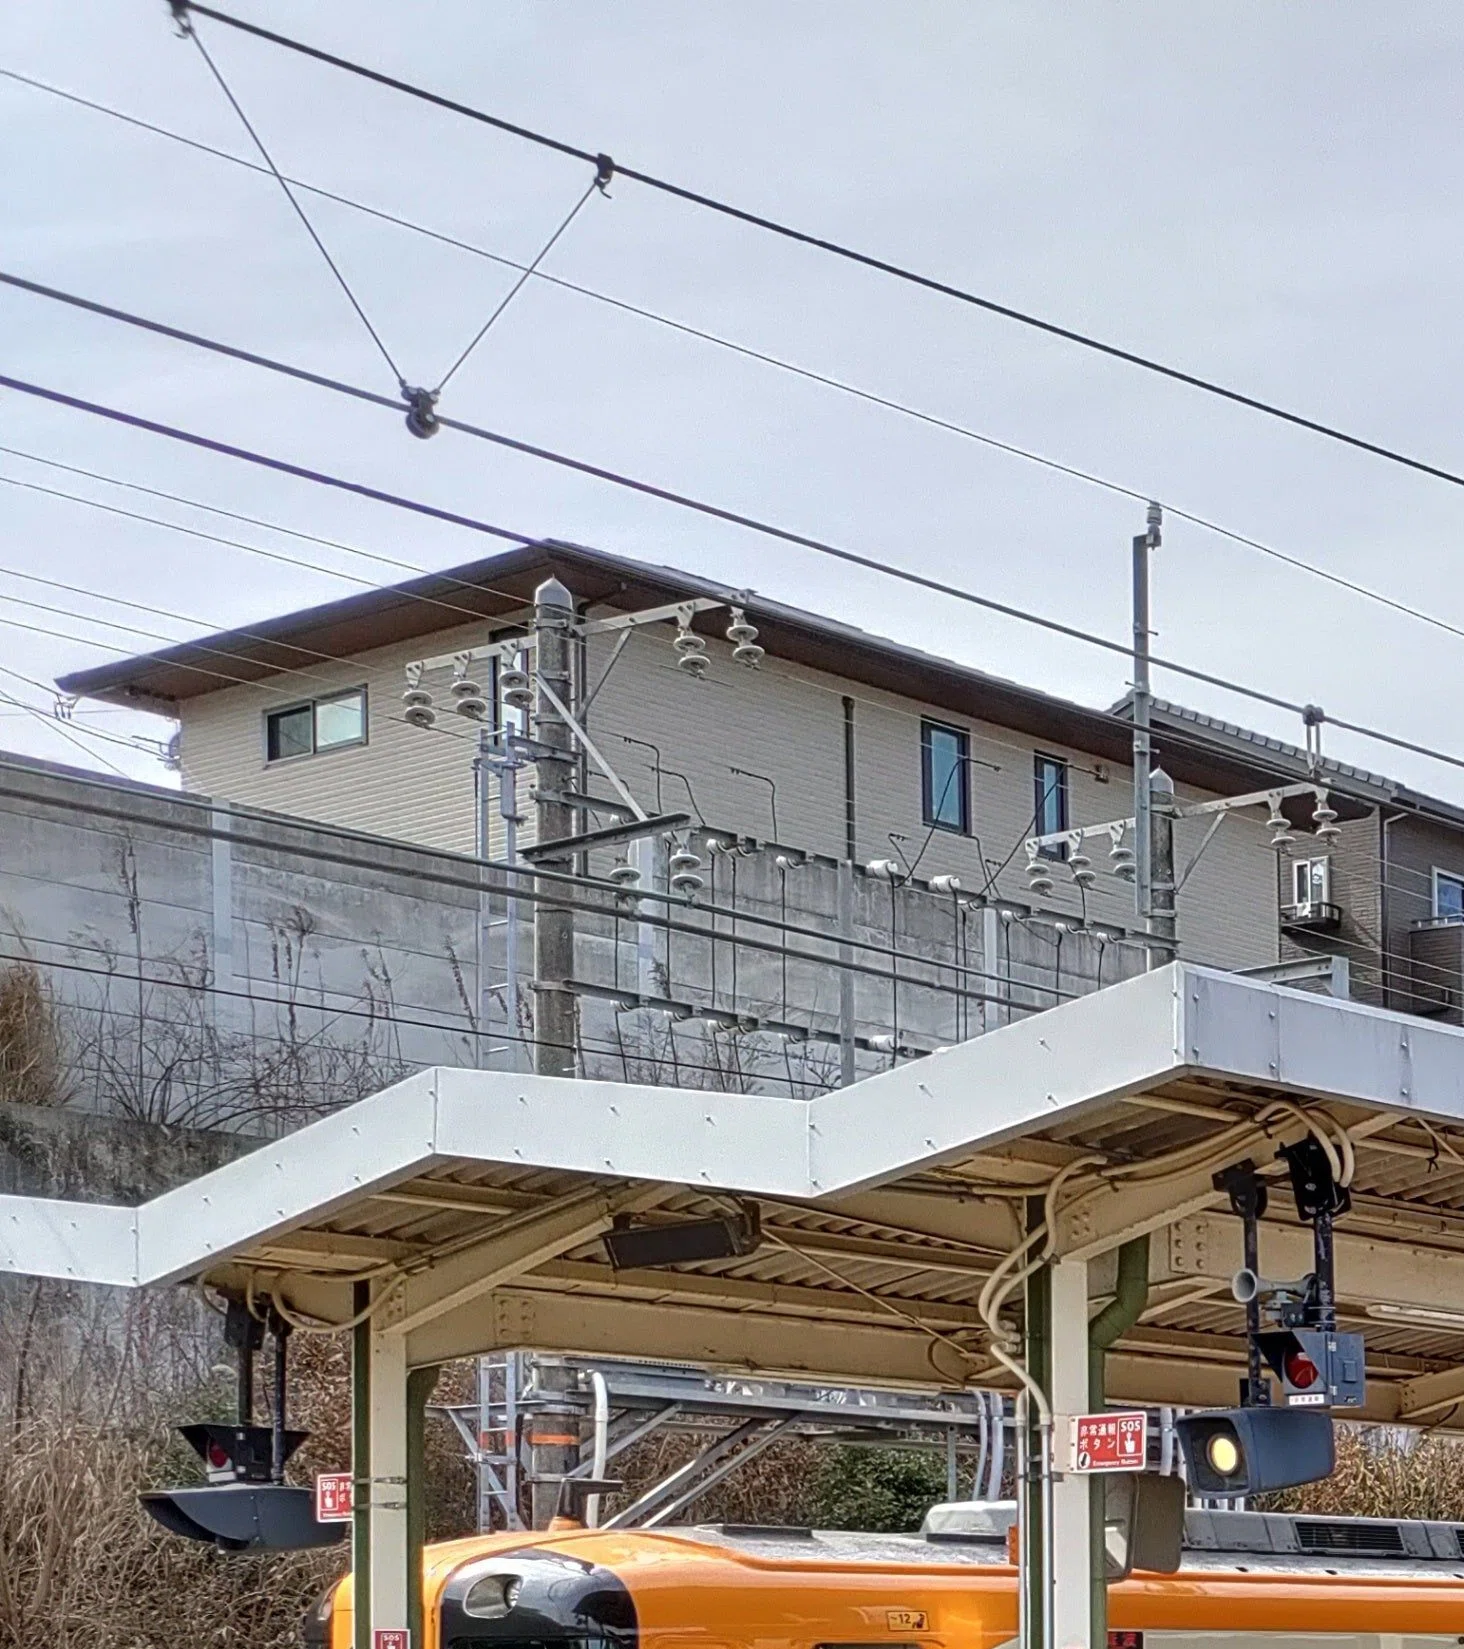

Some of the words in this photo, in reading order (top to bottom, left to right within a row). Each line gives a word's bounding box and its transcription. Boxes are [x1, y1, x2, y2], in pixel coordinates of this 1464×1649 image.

[1120, 1420, 1141, 1432] SOS
[1080, 1437, 1116, 1451] ボタン
